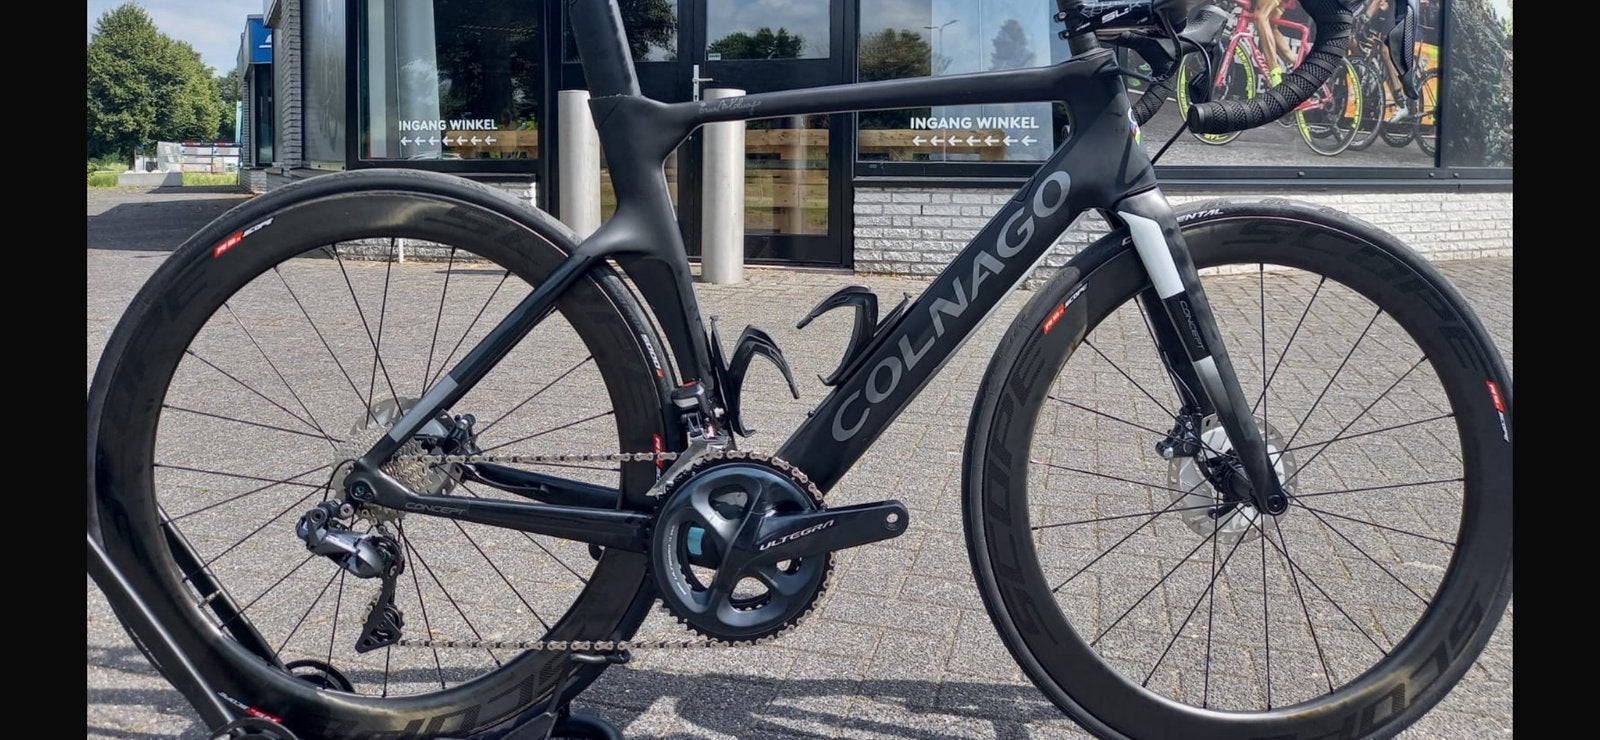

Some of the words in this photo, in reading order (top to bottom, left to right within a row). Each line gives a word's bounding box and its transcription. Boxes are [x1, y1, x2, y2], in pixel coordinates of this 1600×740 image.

[399, 120, 447, 131] INGANG
[450, 119, 498, 131] WINKEL
[910, 116, 972, 130] INGANG
[976, 116, 1039, 130] WINKEL
[831, 170, 1071, 442] COLNAGO
[1180, 300, 1205, 351] CONCEPT
[405, 502, 467, 516] CONCEPT
[759, 519, 835, 551] ULTEGRA
